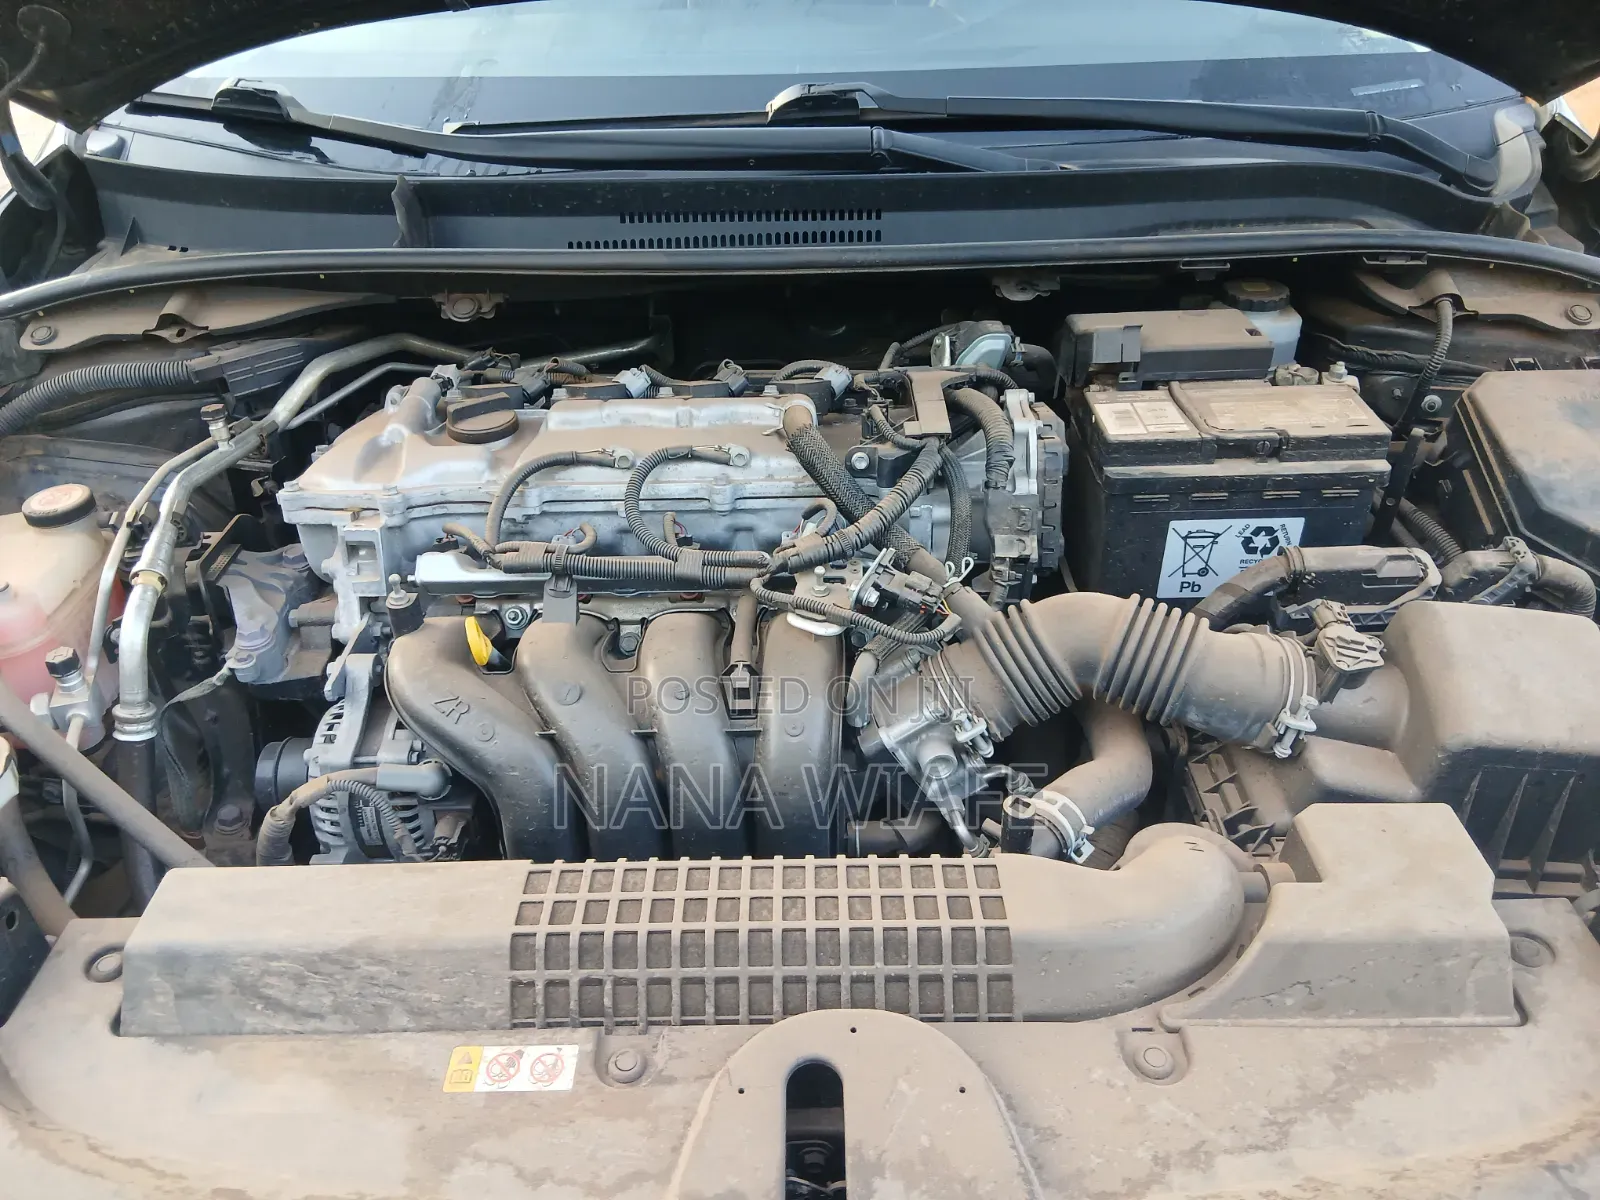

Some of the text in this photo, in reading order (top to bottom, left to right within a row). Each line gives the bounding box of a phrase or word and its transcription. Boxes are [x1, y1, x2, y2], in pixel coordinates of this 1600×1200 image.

[1235, 523, 1251, 538] LEAD
[1280, 523, 1292, 546] RETURN
[1179, 581, 1201, 593] Pb
